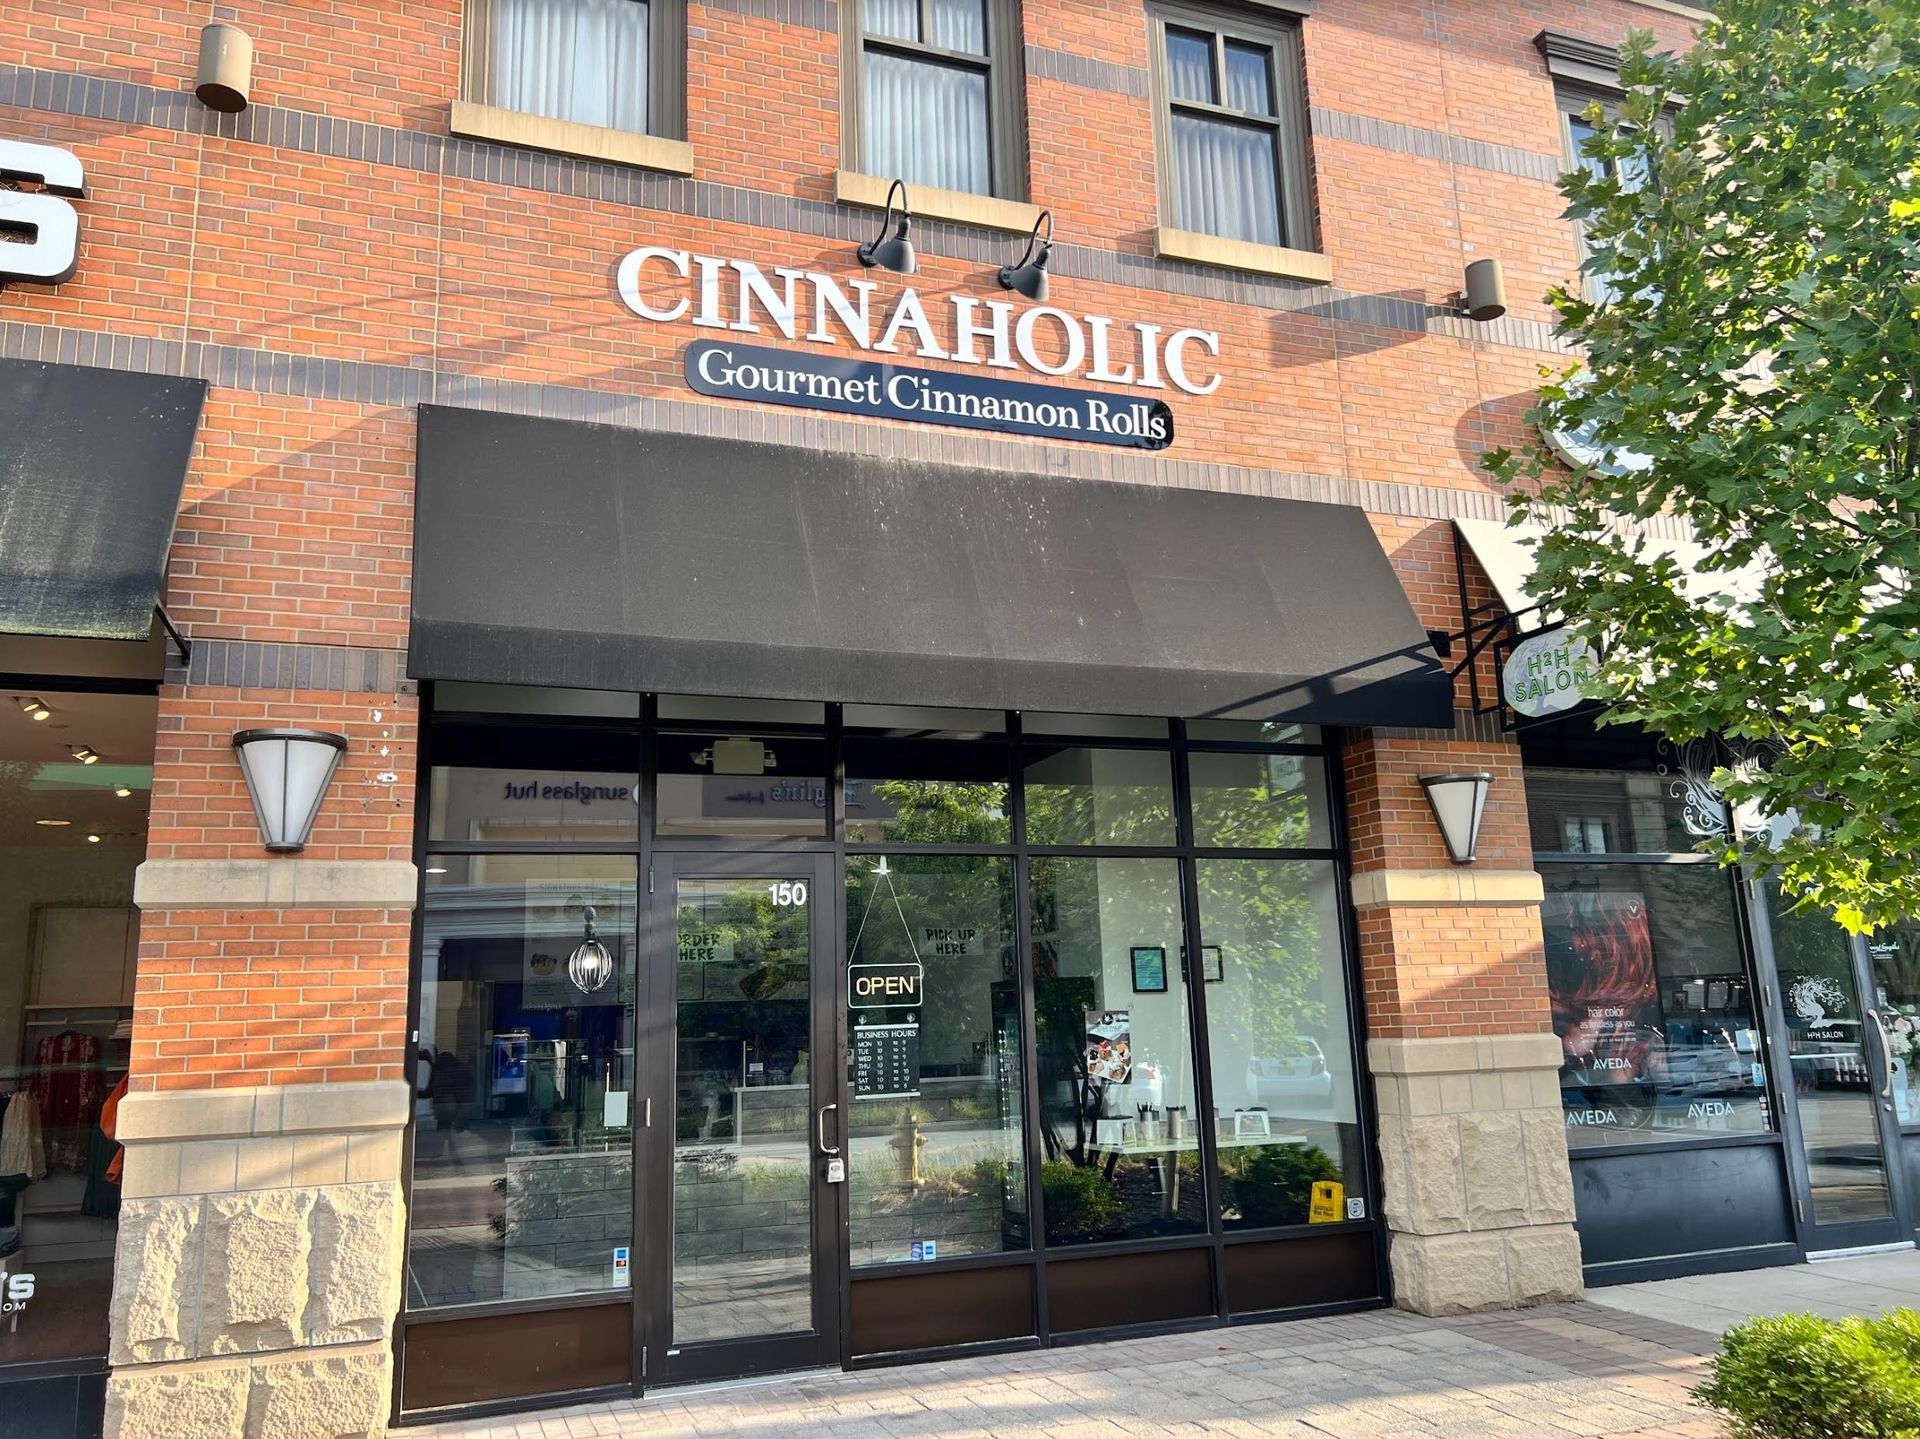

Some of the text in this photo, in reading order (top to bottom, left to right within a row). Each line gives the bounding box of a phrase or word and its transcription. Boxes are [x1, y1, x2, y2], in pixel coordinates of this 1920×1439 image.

[616, 246, 1223, 396] CINNAHOLIC
[697, 348, 1167, 440] Gourmet Cinnamon Rolls
[1515, 669, 1589, 702] SALON
[768, 882, 807, 906] 150
[925, 928, 976, 941] PICK UP
[679, 948, 715, 961] HERE
[936, 943, 967, 955] HERE
[856, 976, 914, 996] OPEN
[1587, 1005, 1624, 1017] hair color
[1623, 1020, 1635, 1029] you
[857, 1031, 889, 1039] BUSINESS
[1822, 1030, 1844, 1039] SALON
[1593, 1058, 1632, 1070] AVEDA
[1687, 1102, 1736, 1119] AVEDA
[1567, 1109, 1617, 1126] AVEDA
